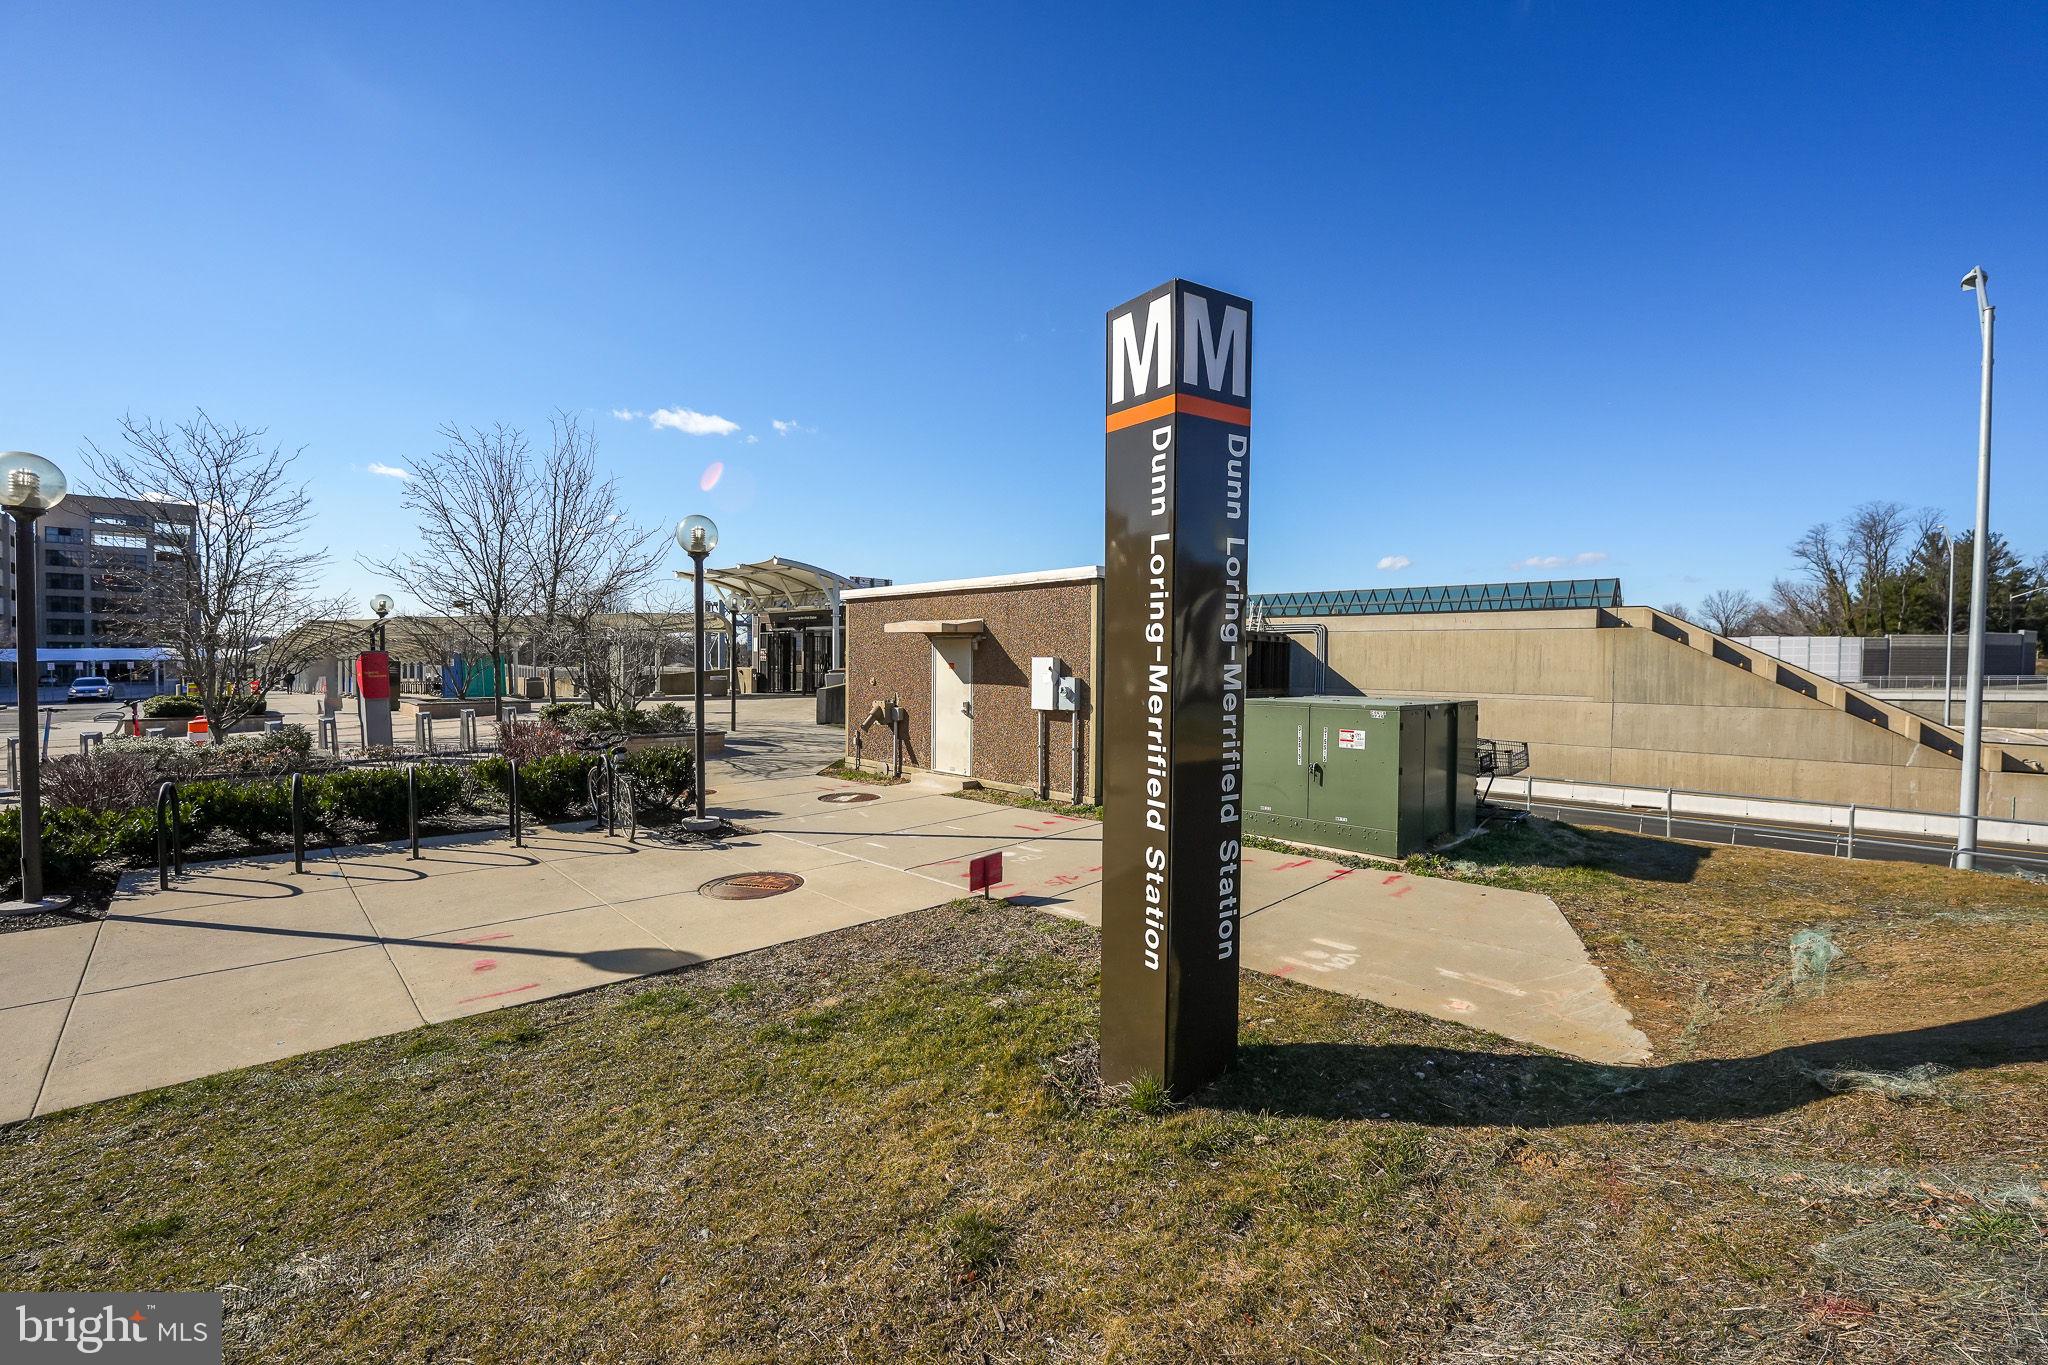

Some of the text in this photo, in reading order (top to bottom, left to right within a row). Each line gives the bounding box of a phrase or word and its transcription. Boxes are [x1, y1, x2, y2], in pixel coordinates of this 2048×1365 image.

[1111, 292, 1171, 404] M
[1183, 291, 1247, 397] M
[1144, 425, 1172, 971] Dunn Loring-Merrifield Station
[1218, 434, 1247, 960] Dunn Loring-Merrifield Station
